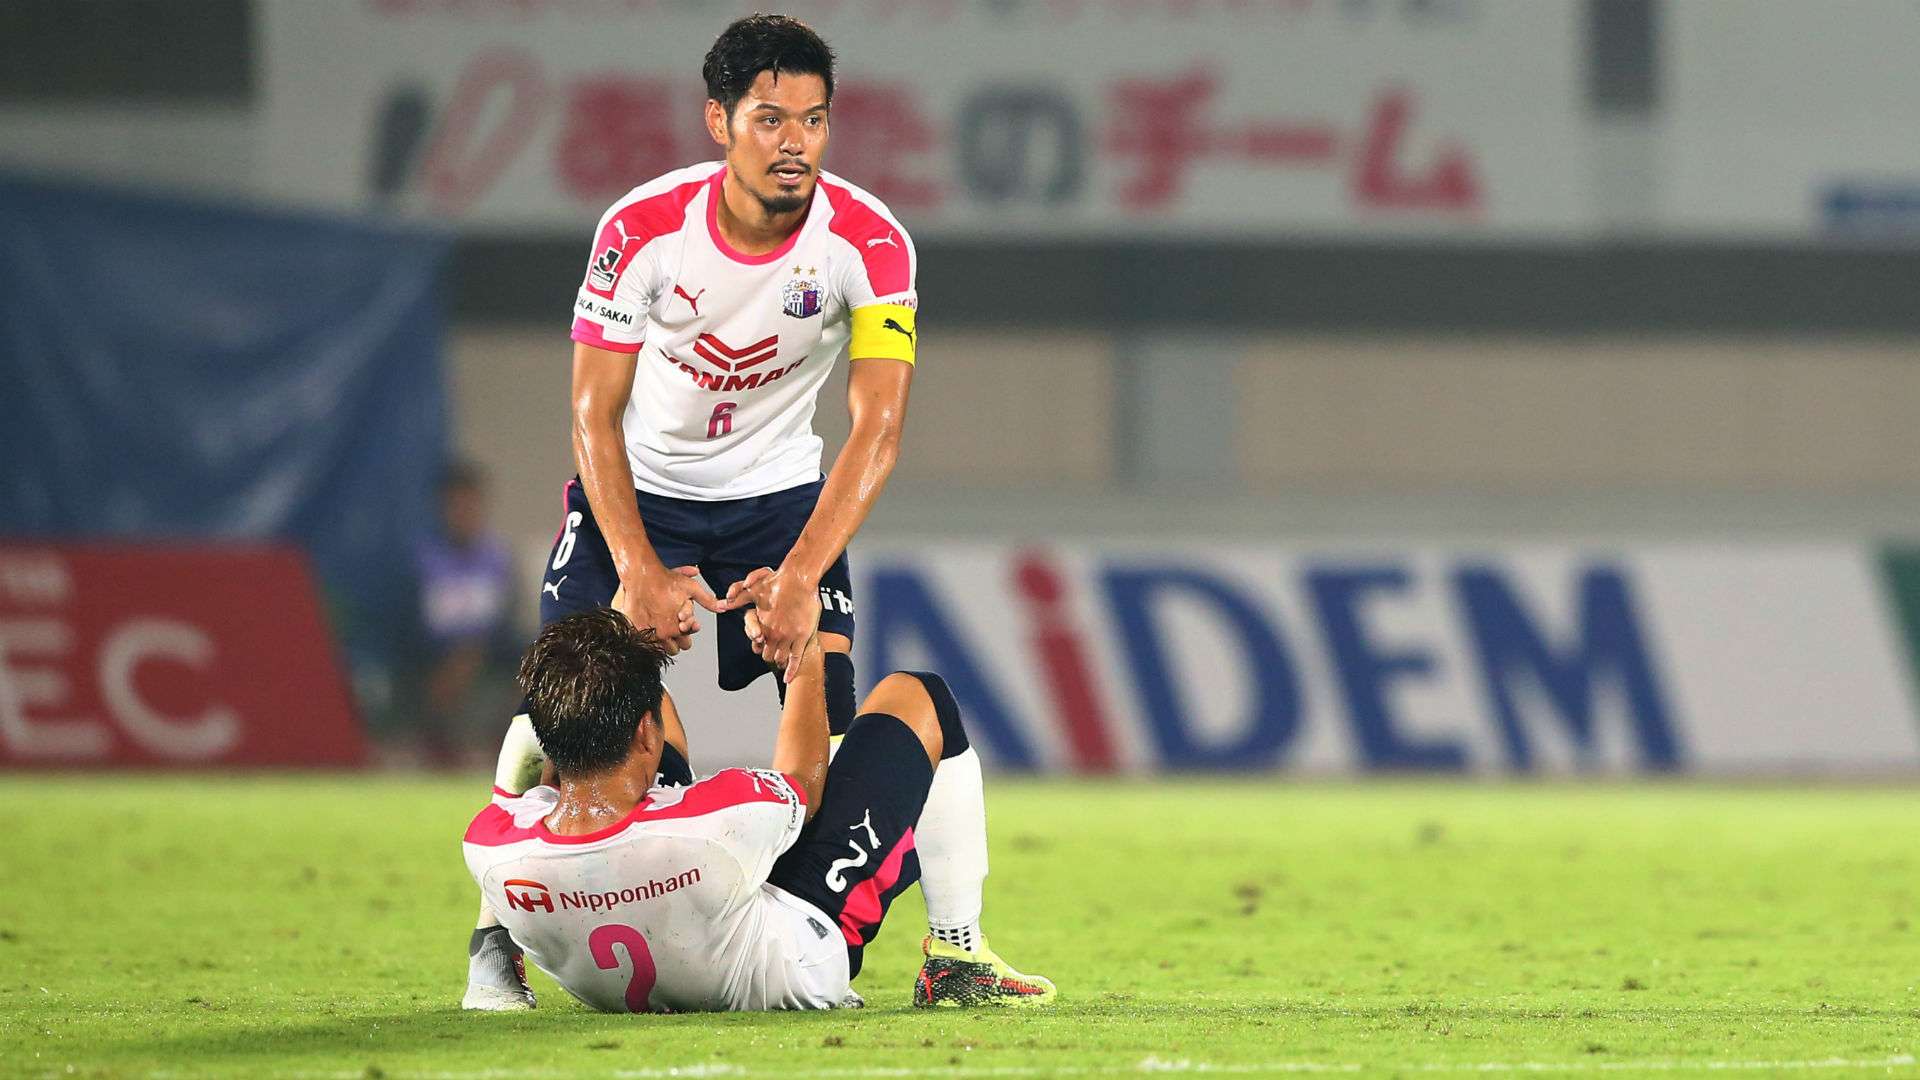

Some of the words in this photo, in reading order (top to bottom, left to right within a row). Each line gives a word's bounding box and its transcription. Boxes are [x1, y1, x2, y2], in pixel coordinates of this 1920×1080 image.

[553, 72, 1484, 212] あたのチーム
[600, 306, 632, 325] SAKAI
[707, 402, 738, 439] 6
[552, 511, 583, 570] 6
[559, 868, 701, 912] Nipponham
[825, 839, 868, 893] 2
